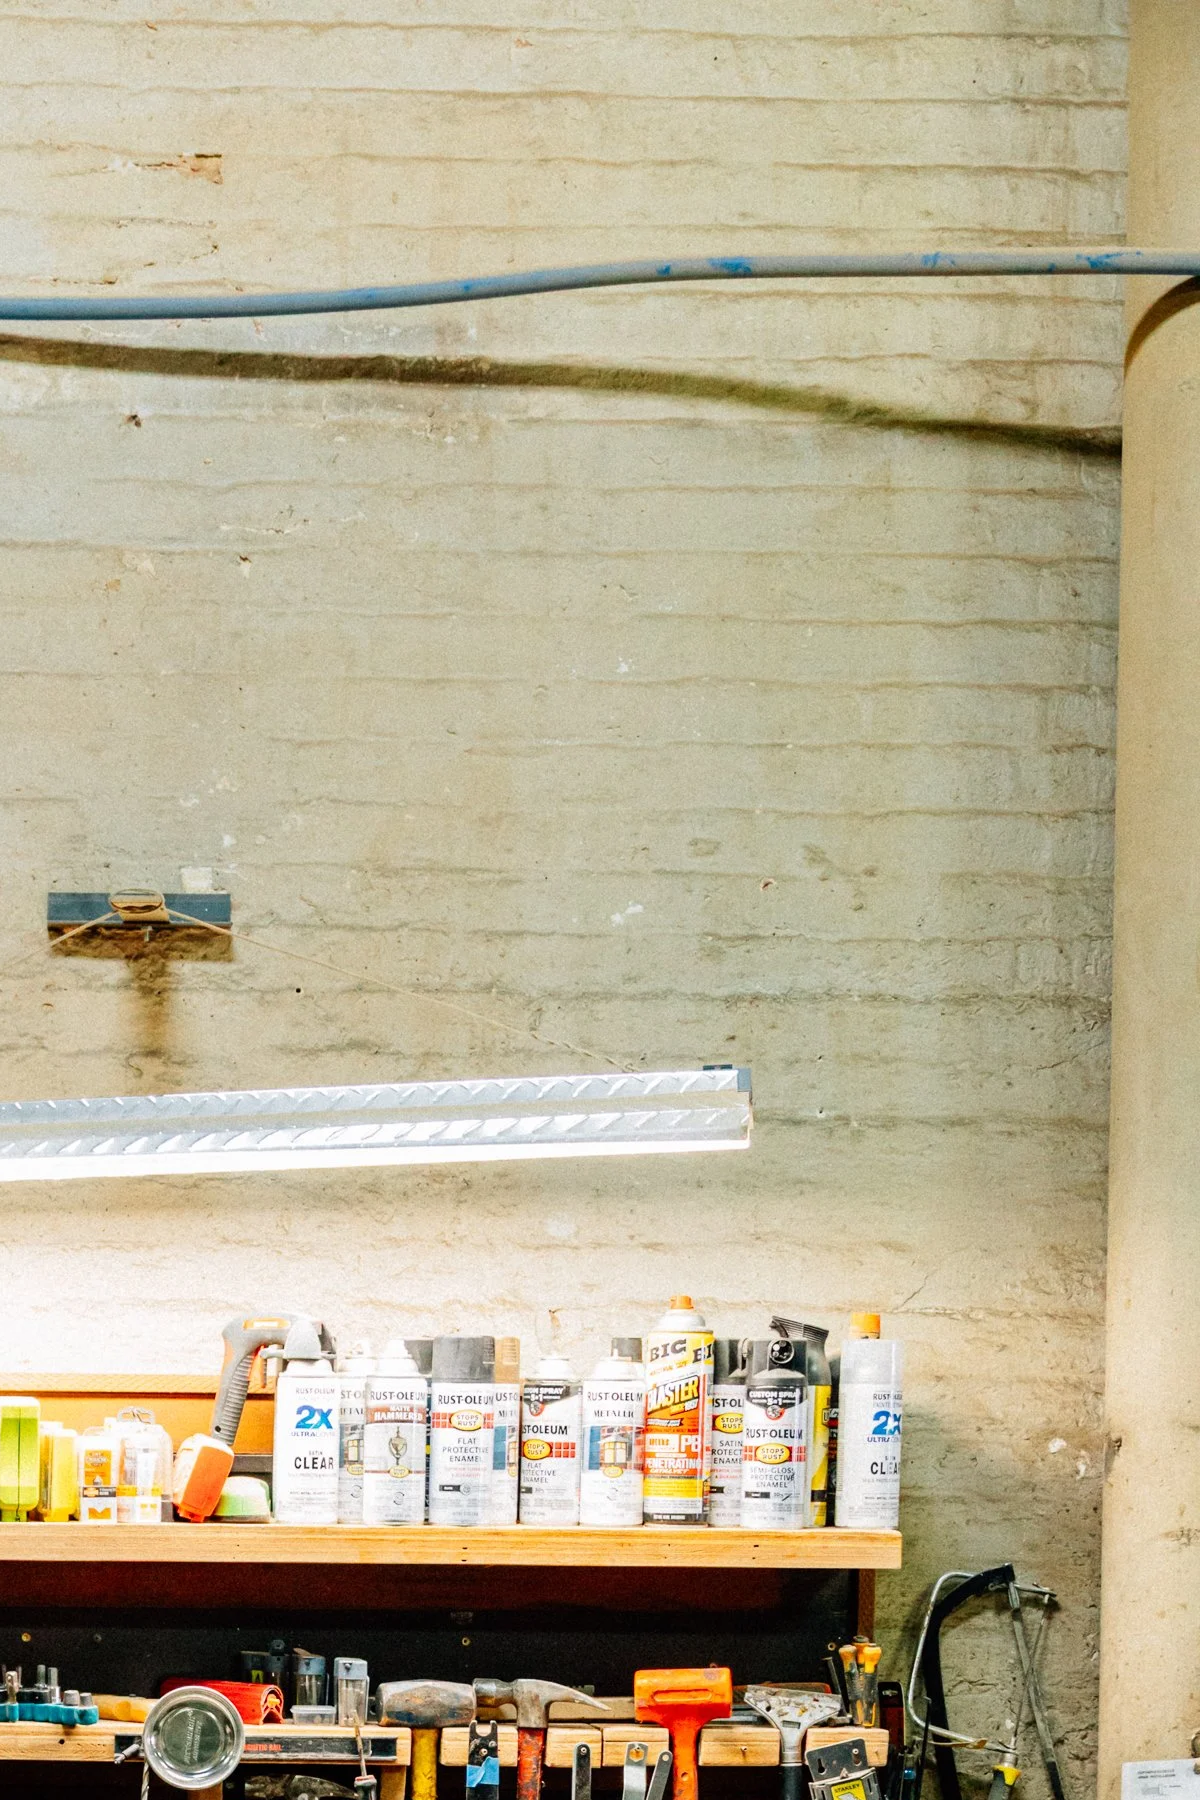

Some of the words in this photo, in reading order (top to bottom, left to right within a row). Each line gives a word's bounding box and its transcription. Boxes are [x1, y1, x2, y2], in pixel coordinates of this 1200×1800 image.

[650, 1338, 687, 1362] BIG
[692, 1343, 713, 1364] BI
[749, 1390, 777, 1399] CUSTOM
[294, 1404, 333, 1430] 2X
[373, 1411, 424, 1422] HAMMERED
[522, 1424, 568, 1436] ST-OLEUM
[457, 1437, 477, 1445] FLAT
[442, 1446, 489, 1454] PROTECTIVE
[294, 1456, 334, 1470] CLEAR
[713, 1457, 743, 1465] ENAME
[834, 1783, 860, 1793] STANLEY
